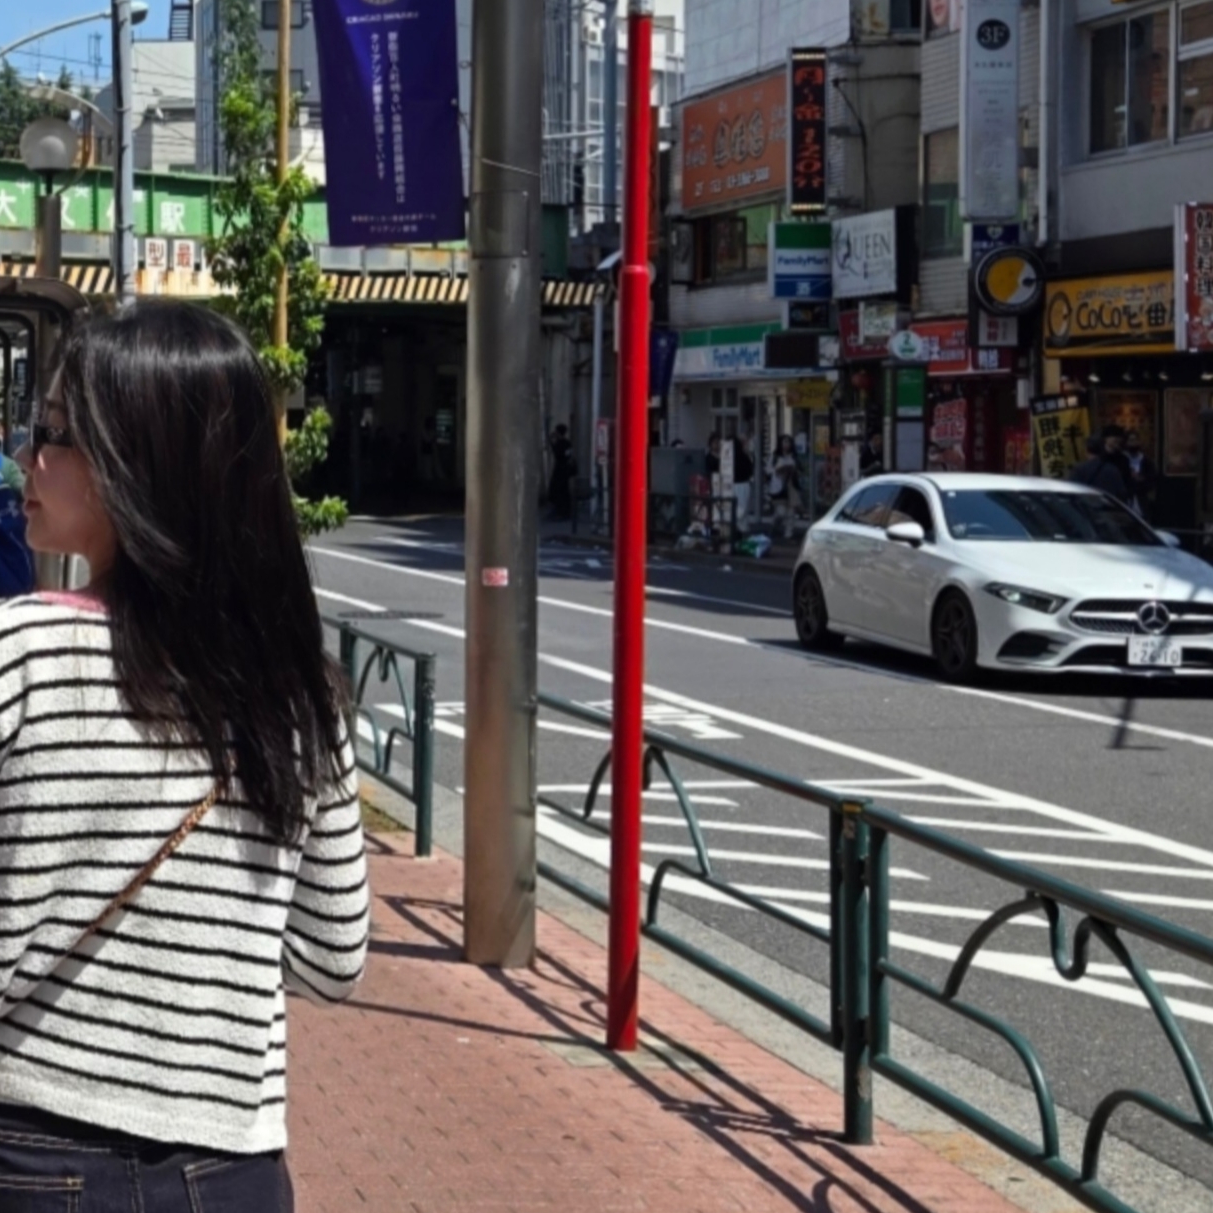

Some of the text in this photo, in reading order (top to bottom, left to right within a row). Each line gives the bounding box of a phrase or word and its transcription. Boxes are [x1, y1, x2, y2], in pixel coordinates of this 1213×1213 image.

[981, 25, 1006, 44] 3F
[777, 254, 830, 267] FamilyMart
[1076, 283, 1175, 331] CoCo壱番
